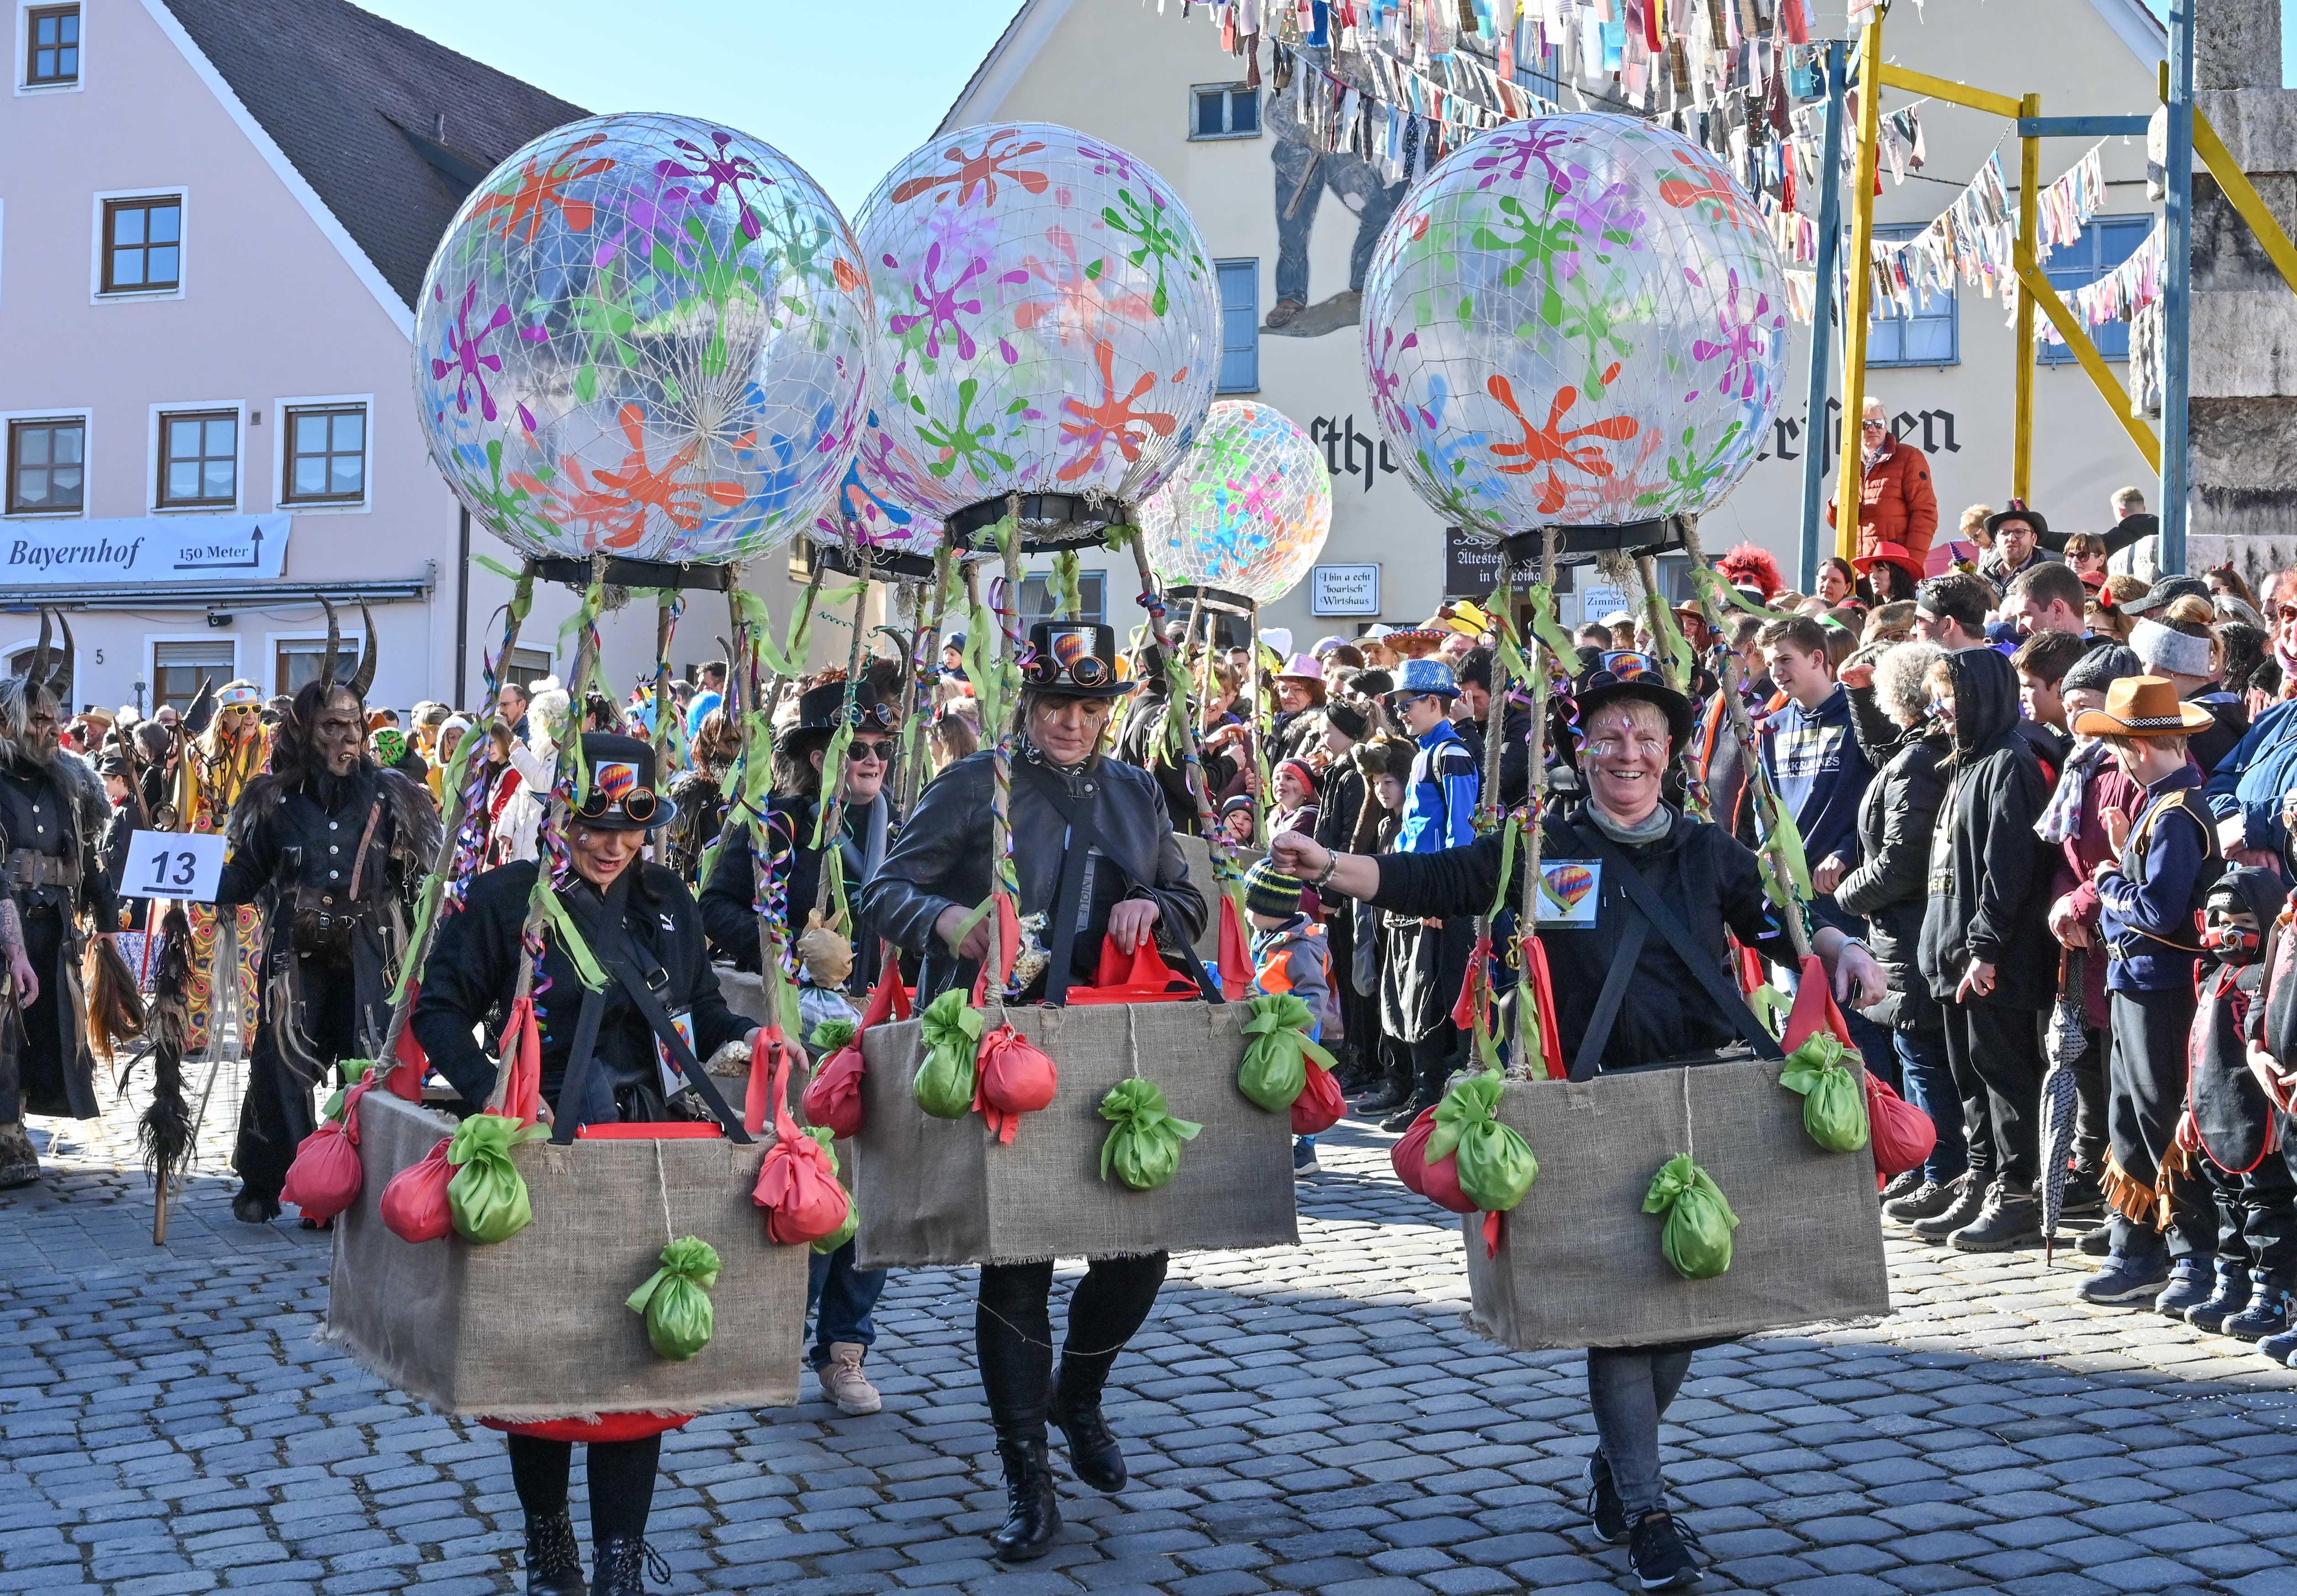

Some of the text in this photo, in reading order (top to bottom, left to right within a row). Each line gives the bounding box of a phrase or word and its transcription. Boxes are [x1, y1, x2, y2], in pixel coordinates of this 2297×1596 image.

[7, 537, 145, 571] Bayernhof
[180, 546, 248, 562] 150 Meter
[1329, 573, 1341, 581] bin
[1353, 572, 1371, 581] echt
[1479, 569, 1490, 582] in
[1320, 596, 1369, 606] Wirtshaus
[1587, 597, 1626, 606] Zimmer
[95, 648, 103, 665] 5
[151, 850, 196, 885] 13
